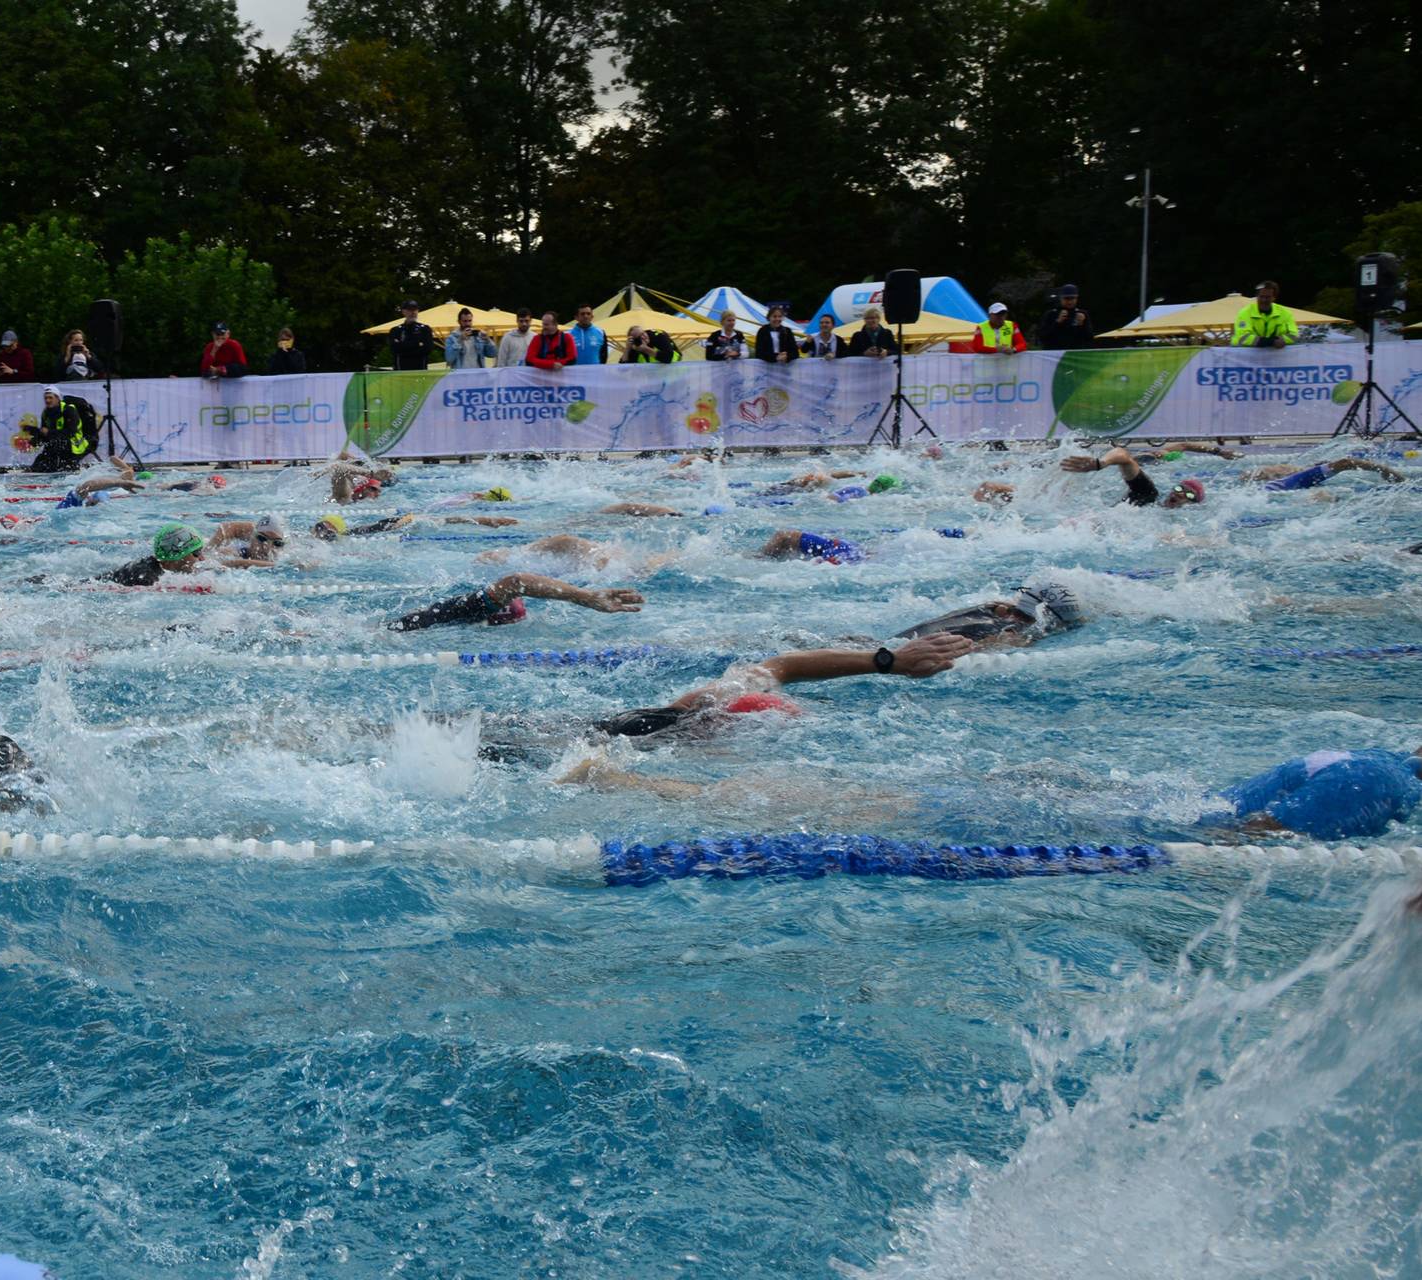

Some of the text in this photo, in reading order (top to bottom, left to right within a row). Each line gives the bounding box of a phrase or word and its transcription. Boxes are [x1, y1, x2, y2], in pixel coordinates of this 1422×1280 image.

[1201, 363, 1348, 385] Stadtwerke
[446, 385, 580, 406] Stadtwerke
[1218, 384, 1330, 406] Ratingen
[199, 397, 332, 431] rapeedo
[463, 404, 565, 424] Ratingen
